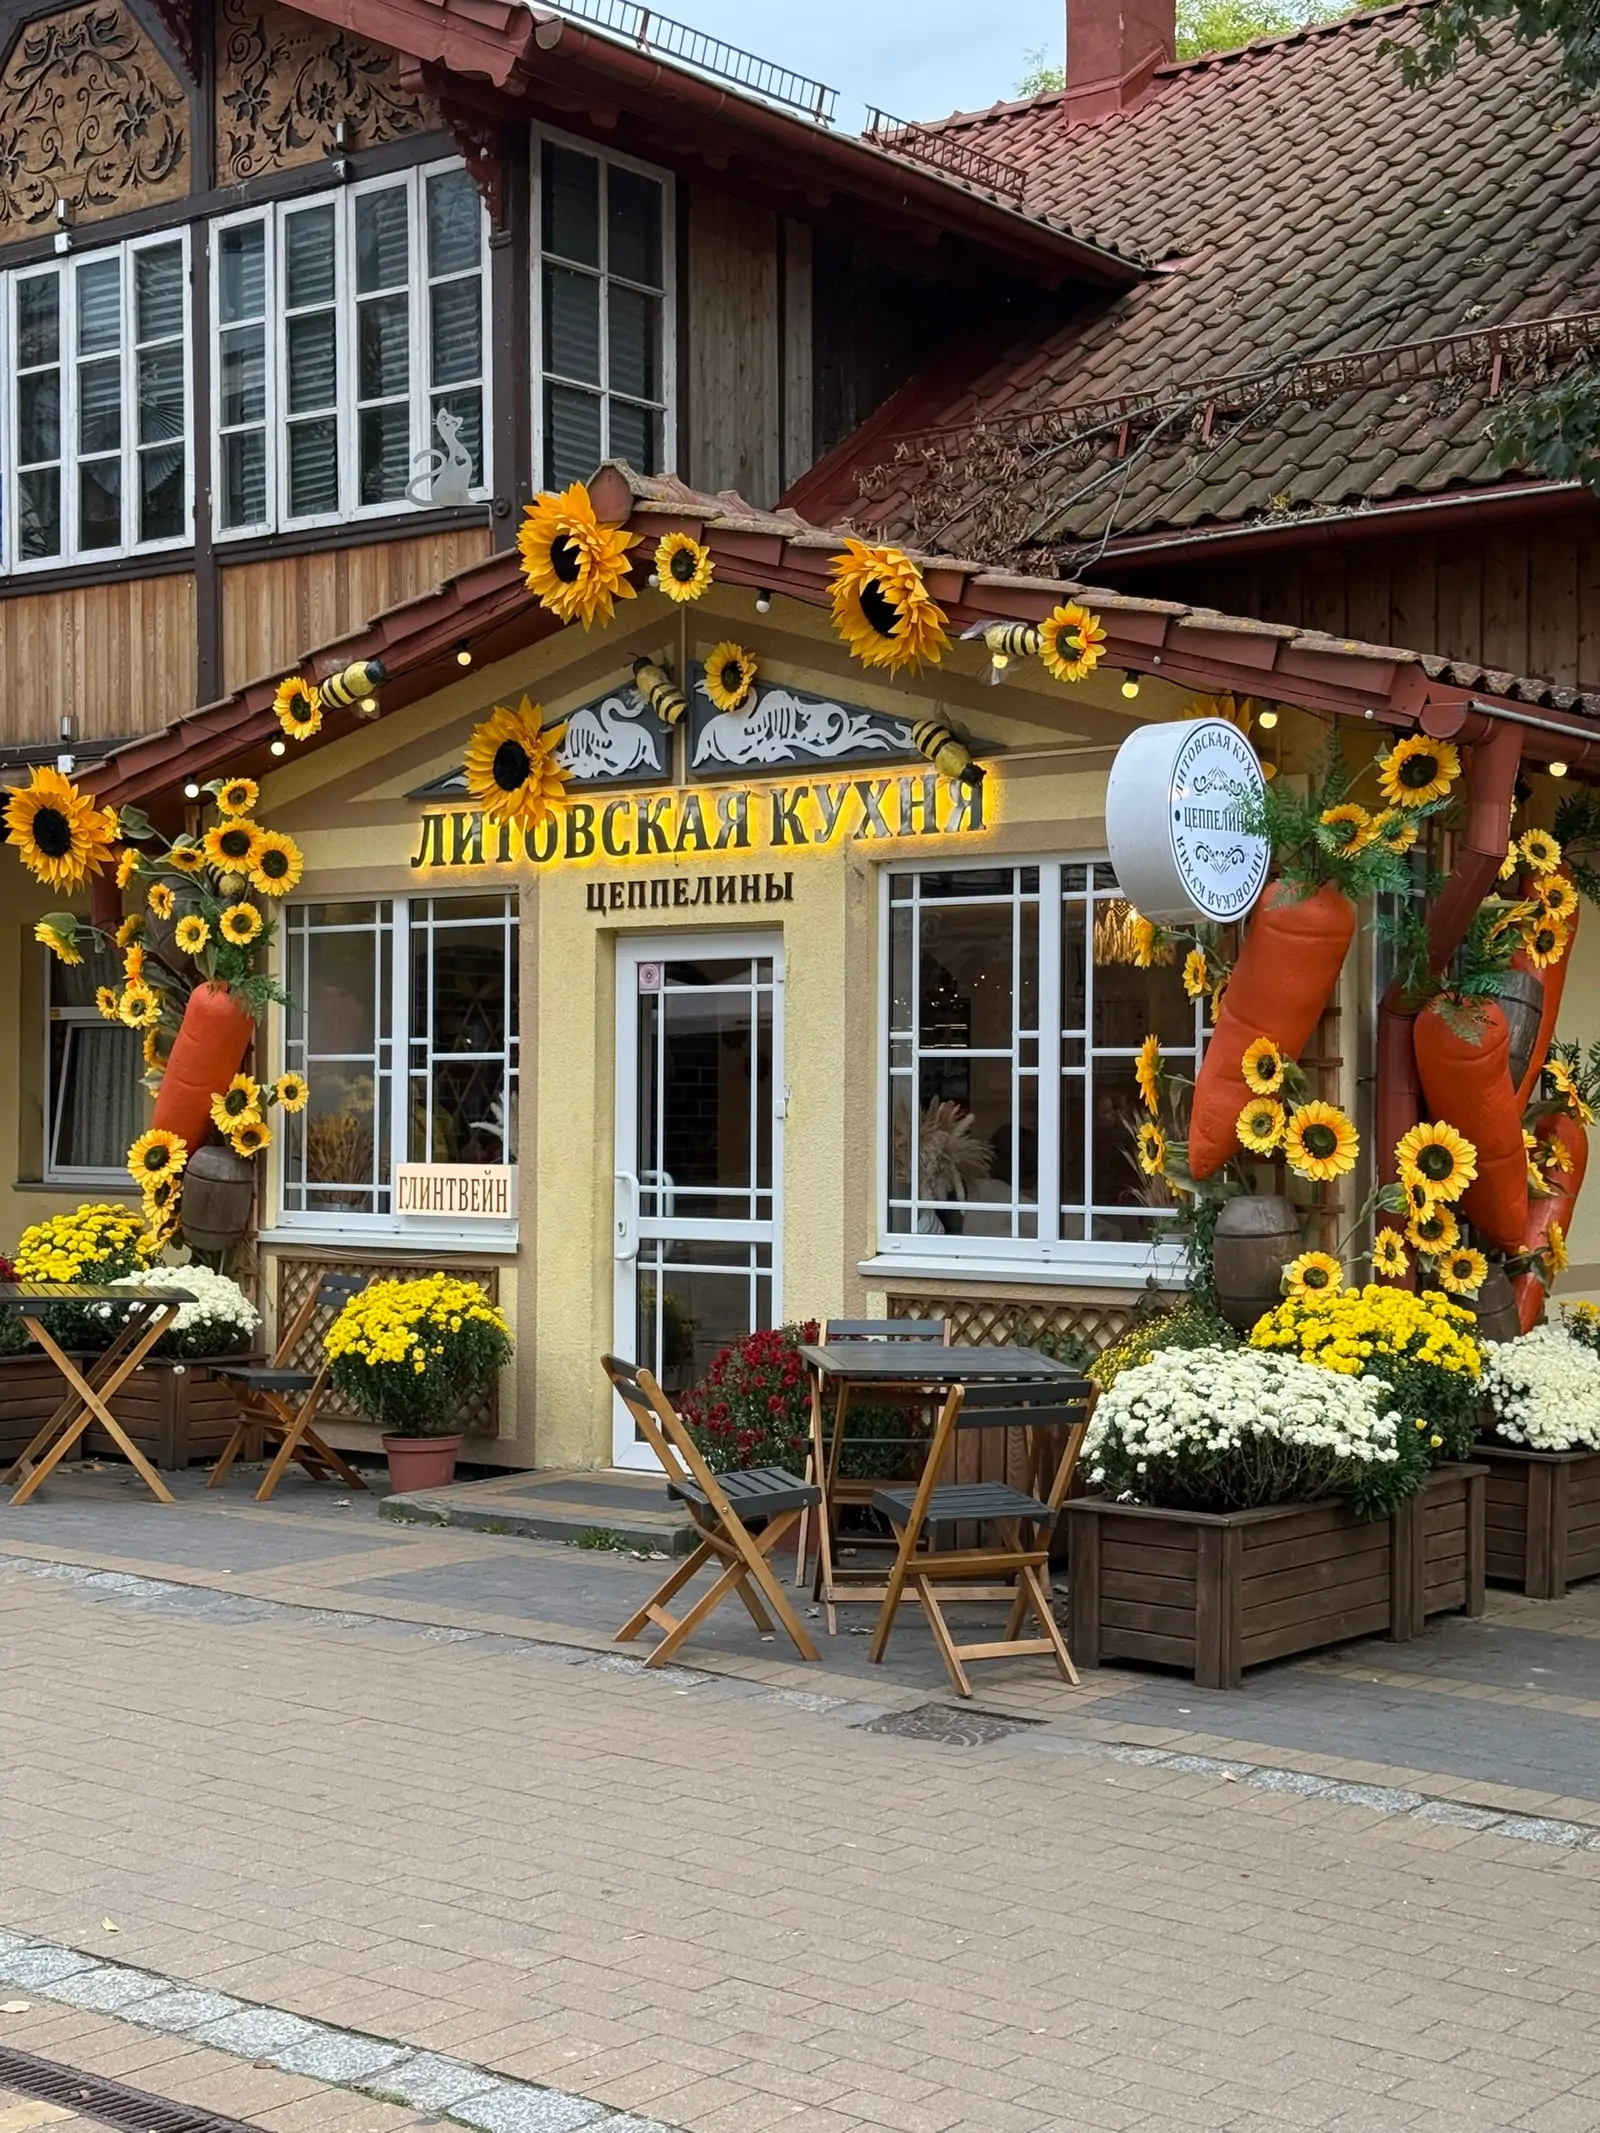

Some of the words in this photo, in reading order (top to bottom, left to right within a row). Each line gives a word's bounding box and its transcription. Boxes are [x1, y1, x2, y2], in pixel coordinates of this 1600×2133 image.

[1175, 732, 1231, 801] ЛИТОВСКАЯ
[411, 789, 751, 868] ЛИТОВСКАЯ
[770, 774, 987, 847] КУХНЯ
[1183, 806, 1250, 833] ЦЕППЕЛИН
[586, 872, 794, 917] ЦЕППЕЛИНЫ
[1176, 835, 1206, 900] КУХНЯ
[1207, 844, 1264, 910] ЛИТОВСКАЯ
[398, 1169, 508, 1213] ГЛИНТВЕЙН
